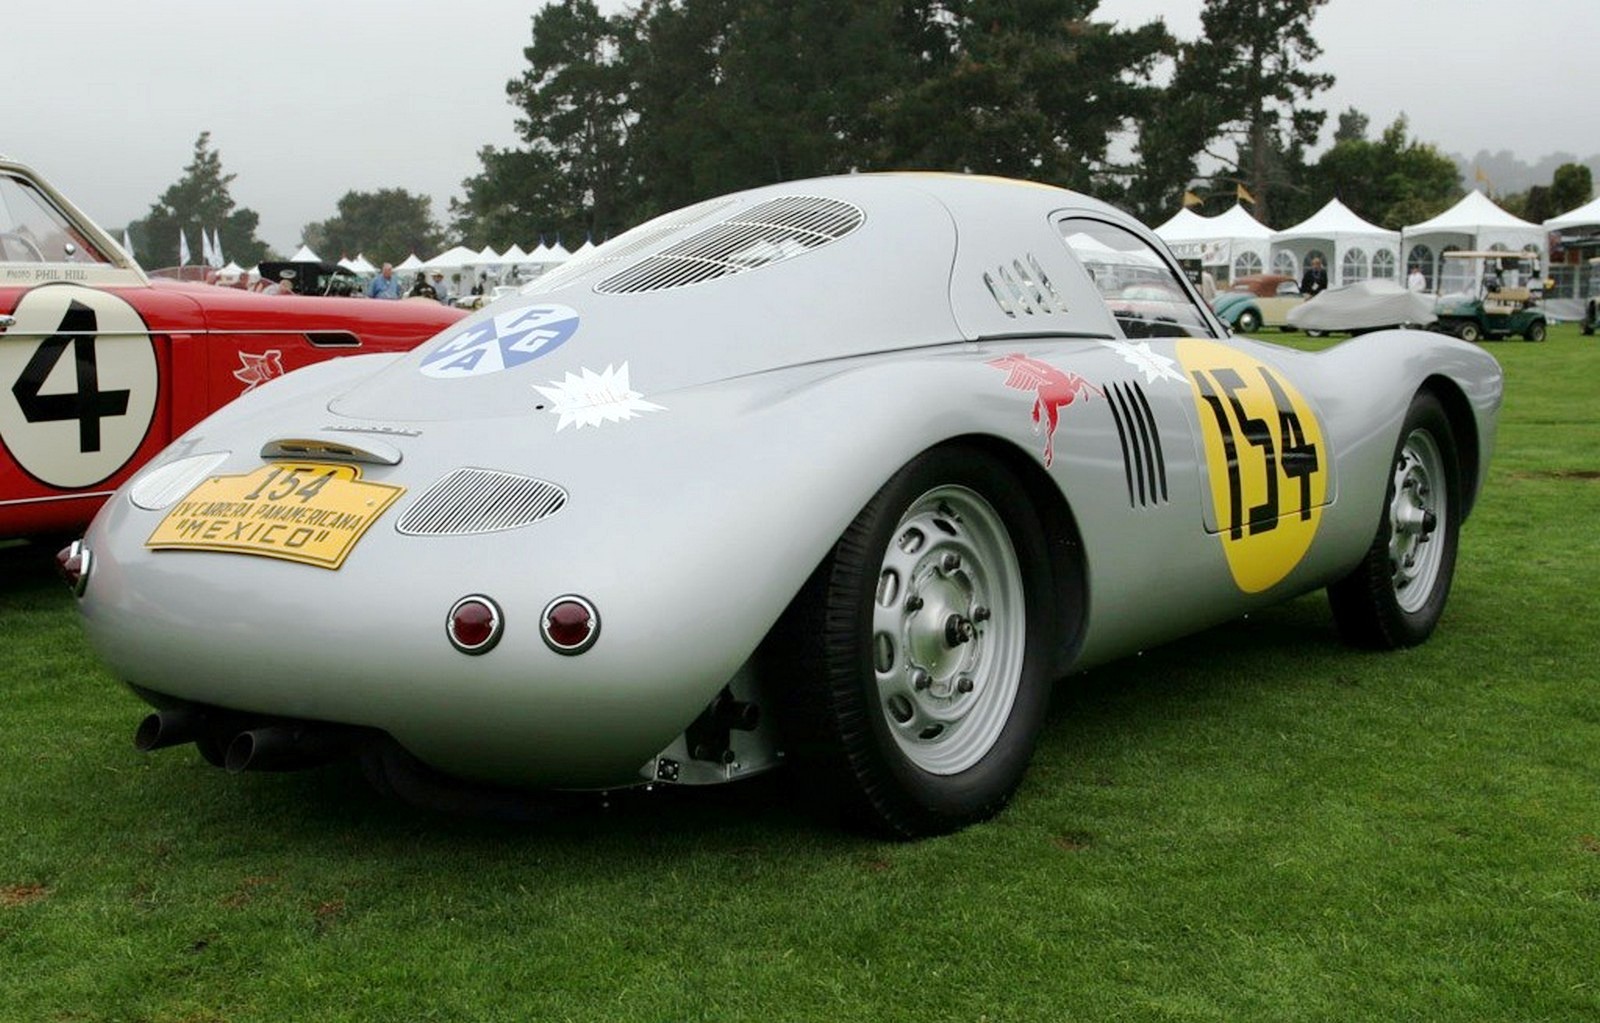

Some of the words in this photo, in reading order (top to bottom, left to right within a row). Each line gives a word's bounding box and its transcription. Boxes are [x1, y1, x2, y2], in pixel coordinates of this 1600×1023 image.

[35, 269, 60, 280] PHIL
[65, 269, 88, 280] HILL
[506, 308, 556, 329] F
[508, 328, 560, 353] G
[439, 348, 488, 371] A
[11, 299, 130, 453] 4
[1191, 366, 1319, 541] 154
[244, 465, 338, 503] 154
[172, 501, 194, 517] IV
[190, 501, 256, 518] CARRERA
[251, 503, 364, 532] PANAMERICANA
[175, 518, 330, 548] "MEXICO"
